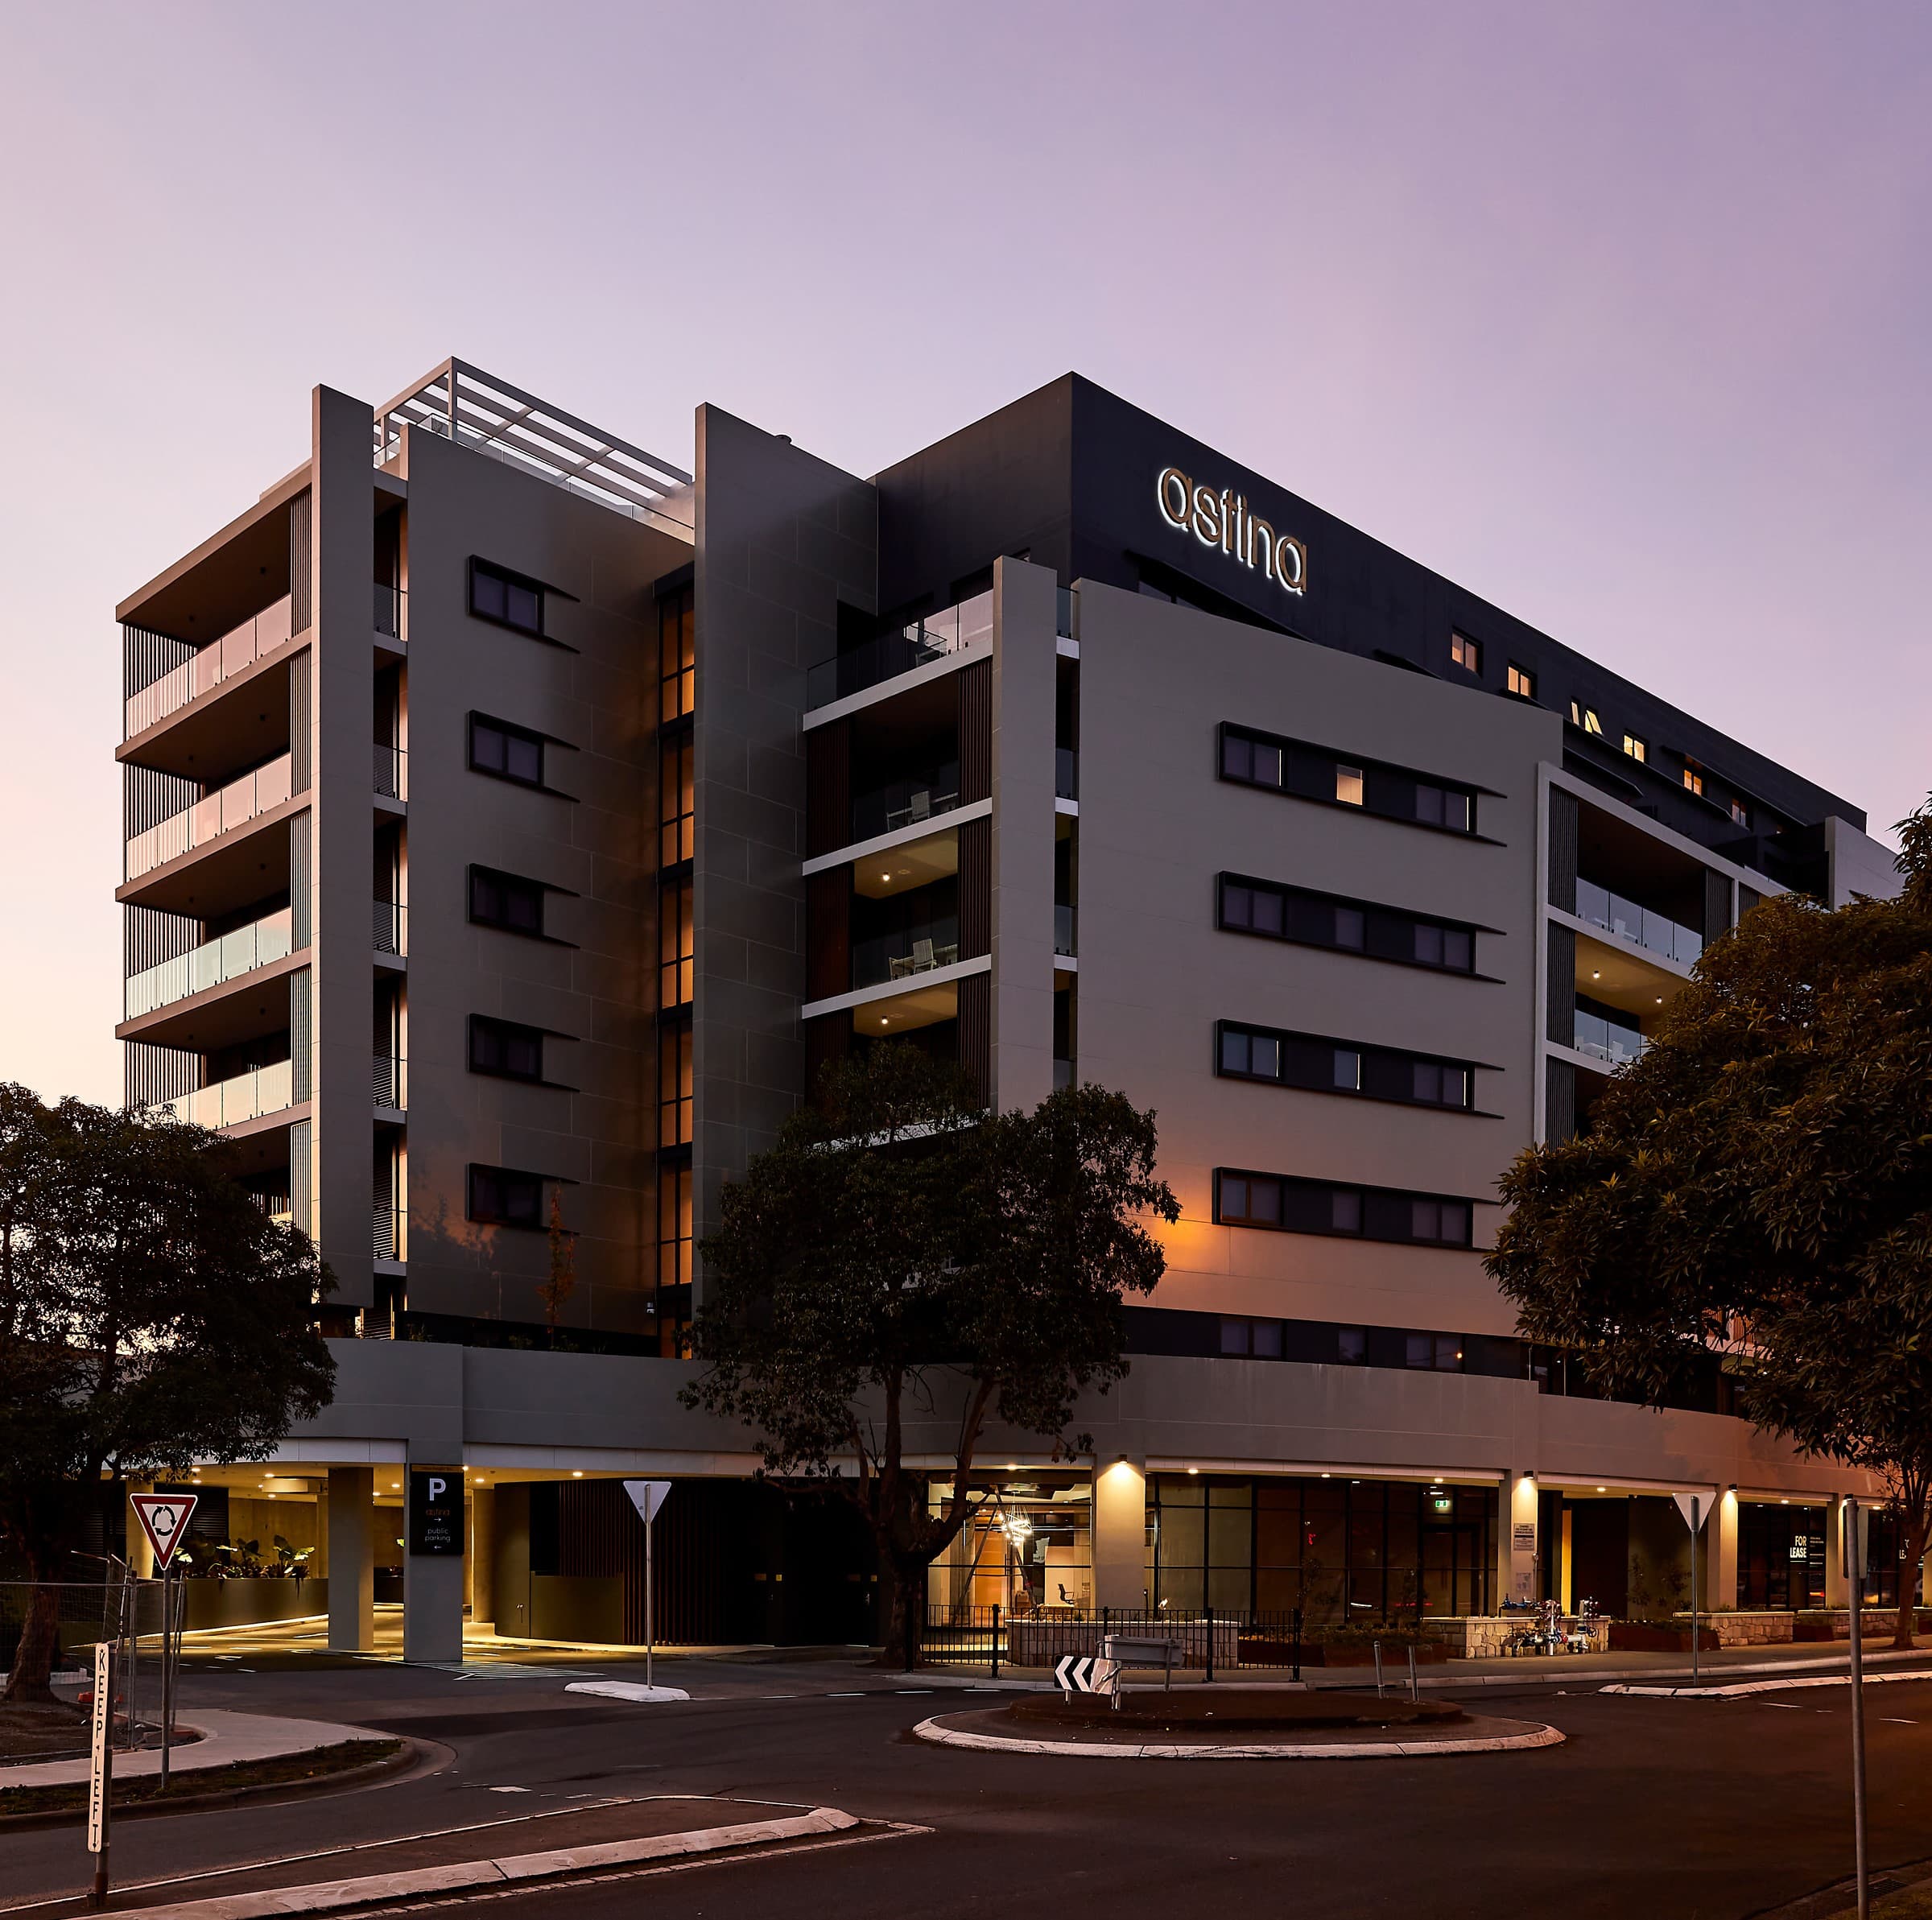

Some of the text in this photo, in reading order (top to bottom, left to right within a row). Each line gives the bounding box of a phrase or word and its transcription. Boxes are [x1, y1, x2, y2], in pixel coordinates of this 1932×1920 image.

[1158, 468, 1307, 596] astina
[429, 1477, 446, 1501] P
[1794, 1535, 1807, 1546] FOR
[1790, 1547, 1807, 1559] LEASE
[93, 1652, 105, 1842] KEEP LEFT
